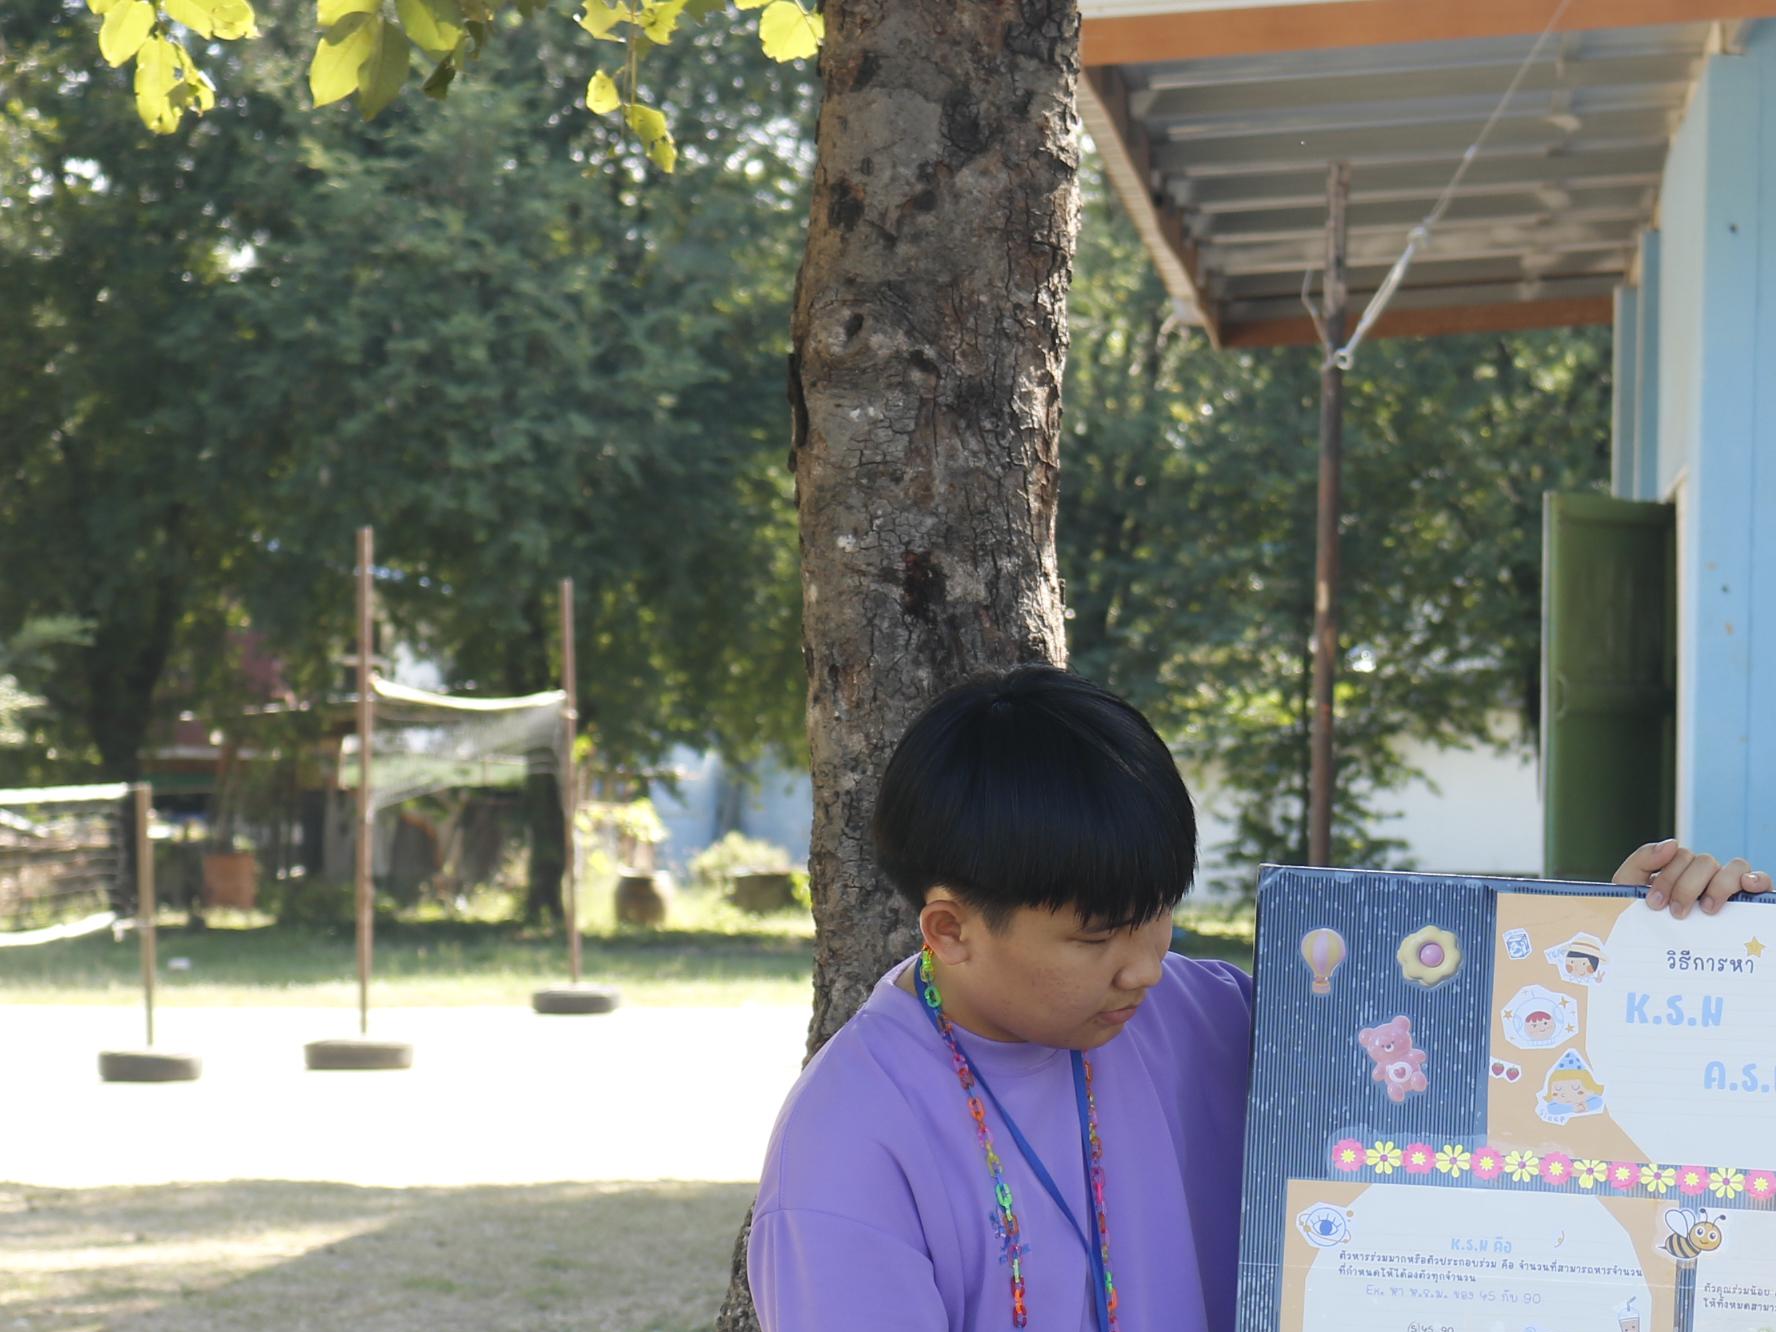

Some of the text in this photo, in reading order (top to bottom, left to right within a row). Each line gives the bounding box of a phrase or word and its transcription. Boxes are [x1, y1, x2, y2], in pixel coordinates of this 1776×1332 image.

[1666, 950, 1754, 974] วิธีการหา
[1494, 1236, 1512, 1254] คือ
[1501, 1258, 1514, 1270] คือ
[1479, 1290, 1496, 1301] 45
[1523, 1292, 1542, 1304] 90
